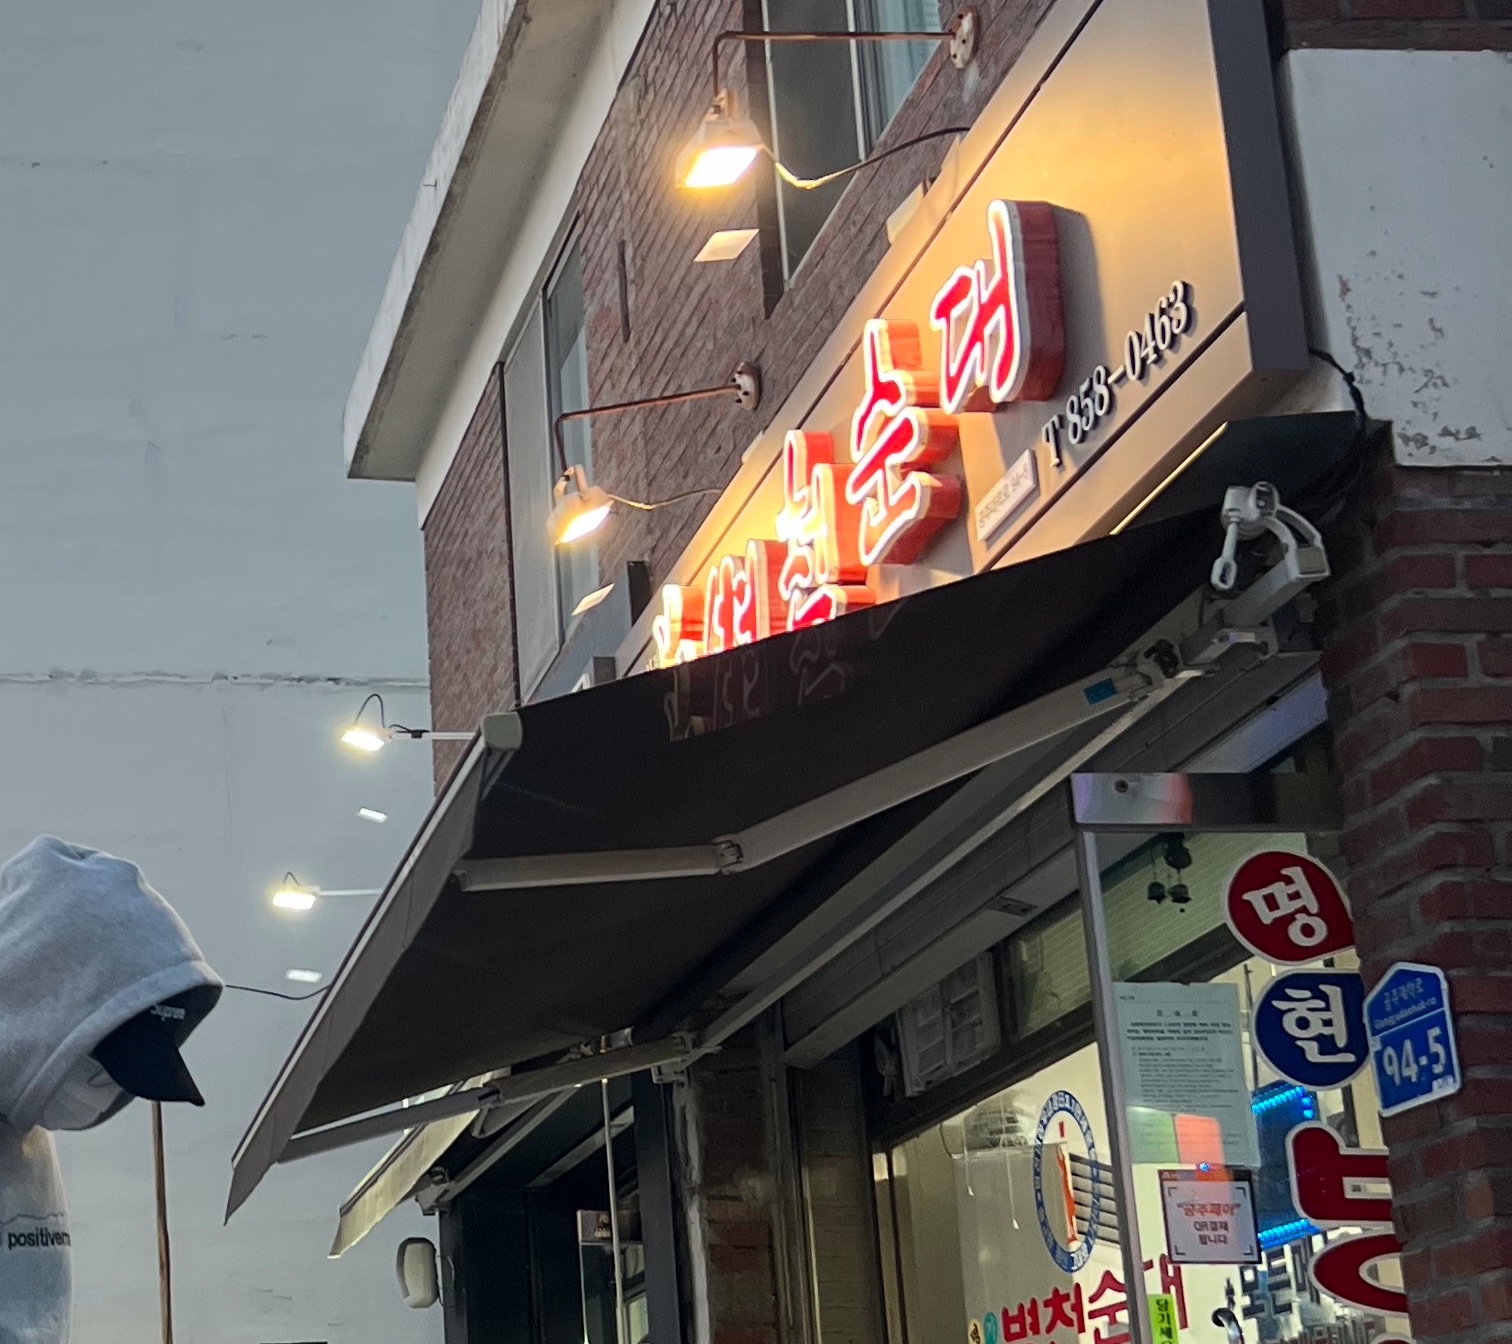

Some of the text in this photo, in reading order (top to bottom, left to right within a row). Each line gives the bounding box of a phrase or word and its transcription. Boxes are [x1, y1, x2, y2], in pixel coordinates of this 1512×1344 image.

[1065, 279, 1188, 445] 858-0463
[1270, 983, 1357, 1064] 현
[1382, 1026, 1447, 1087] 94-5
